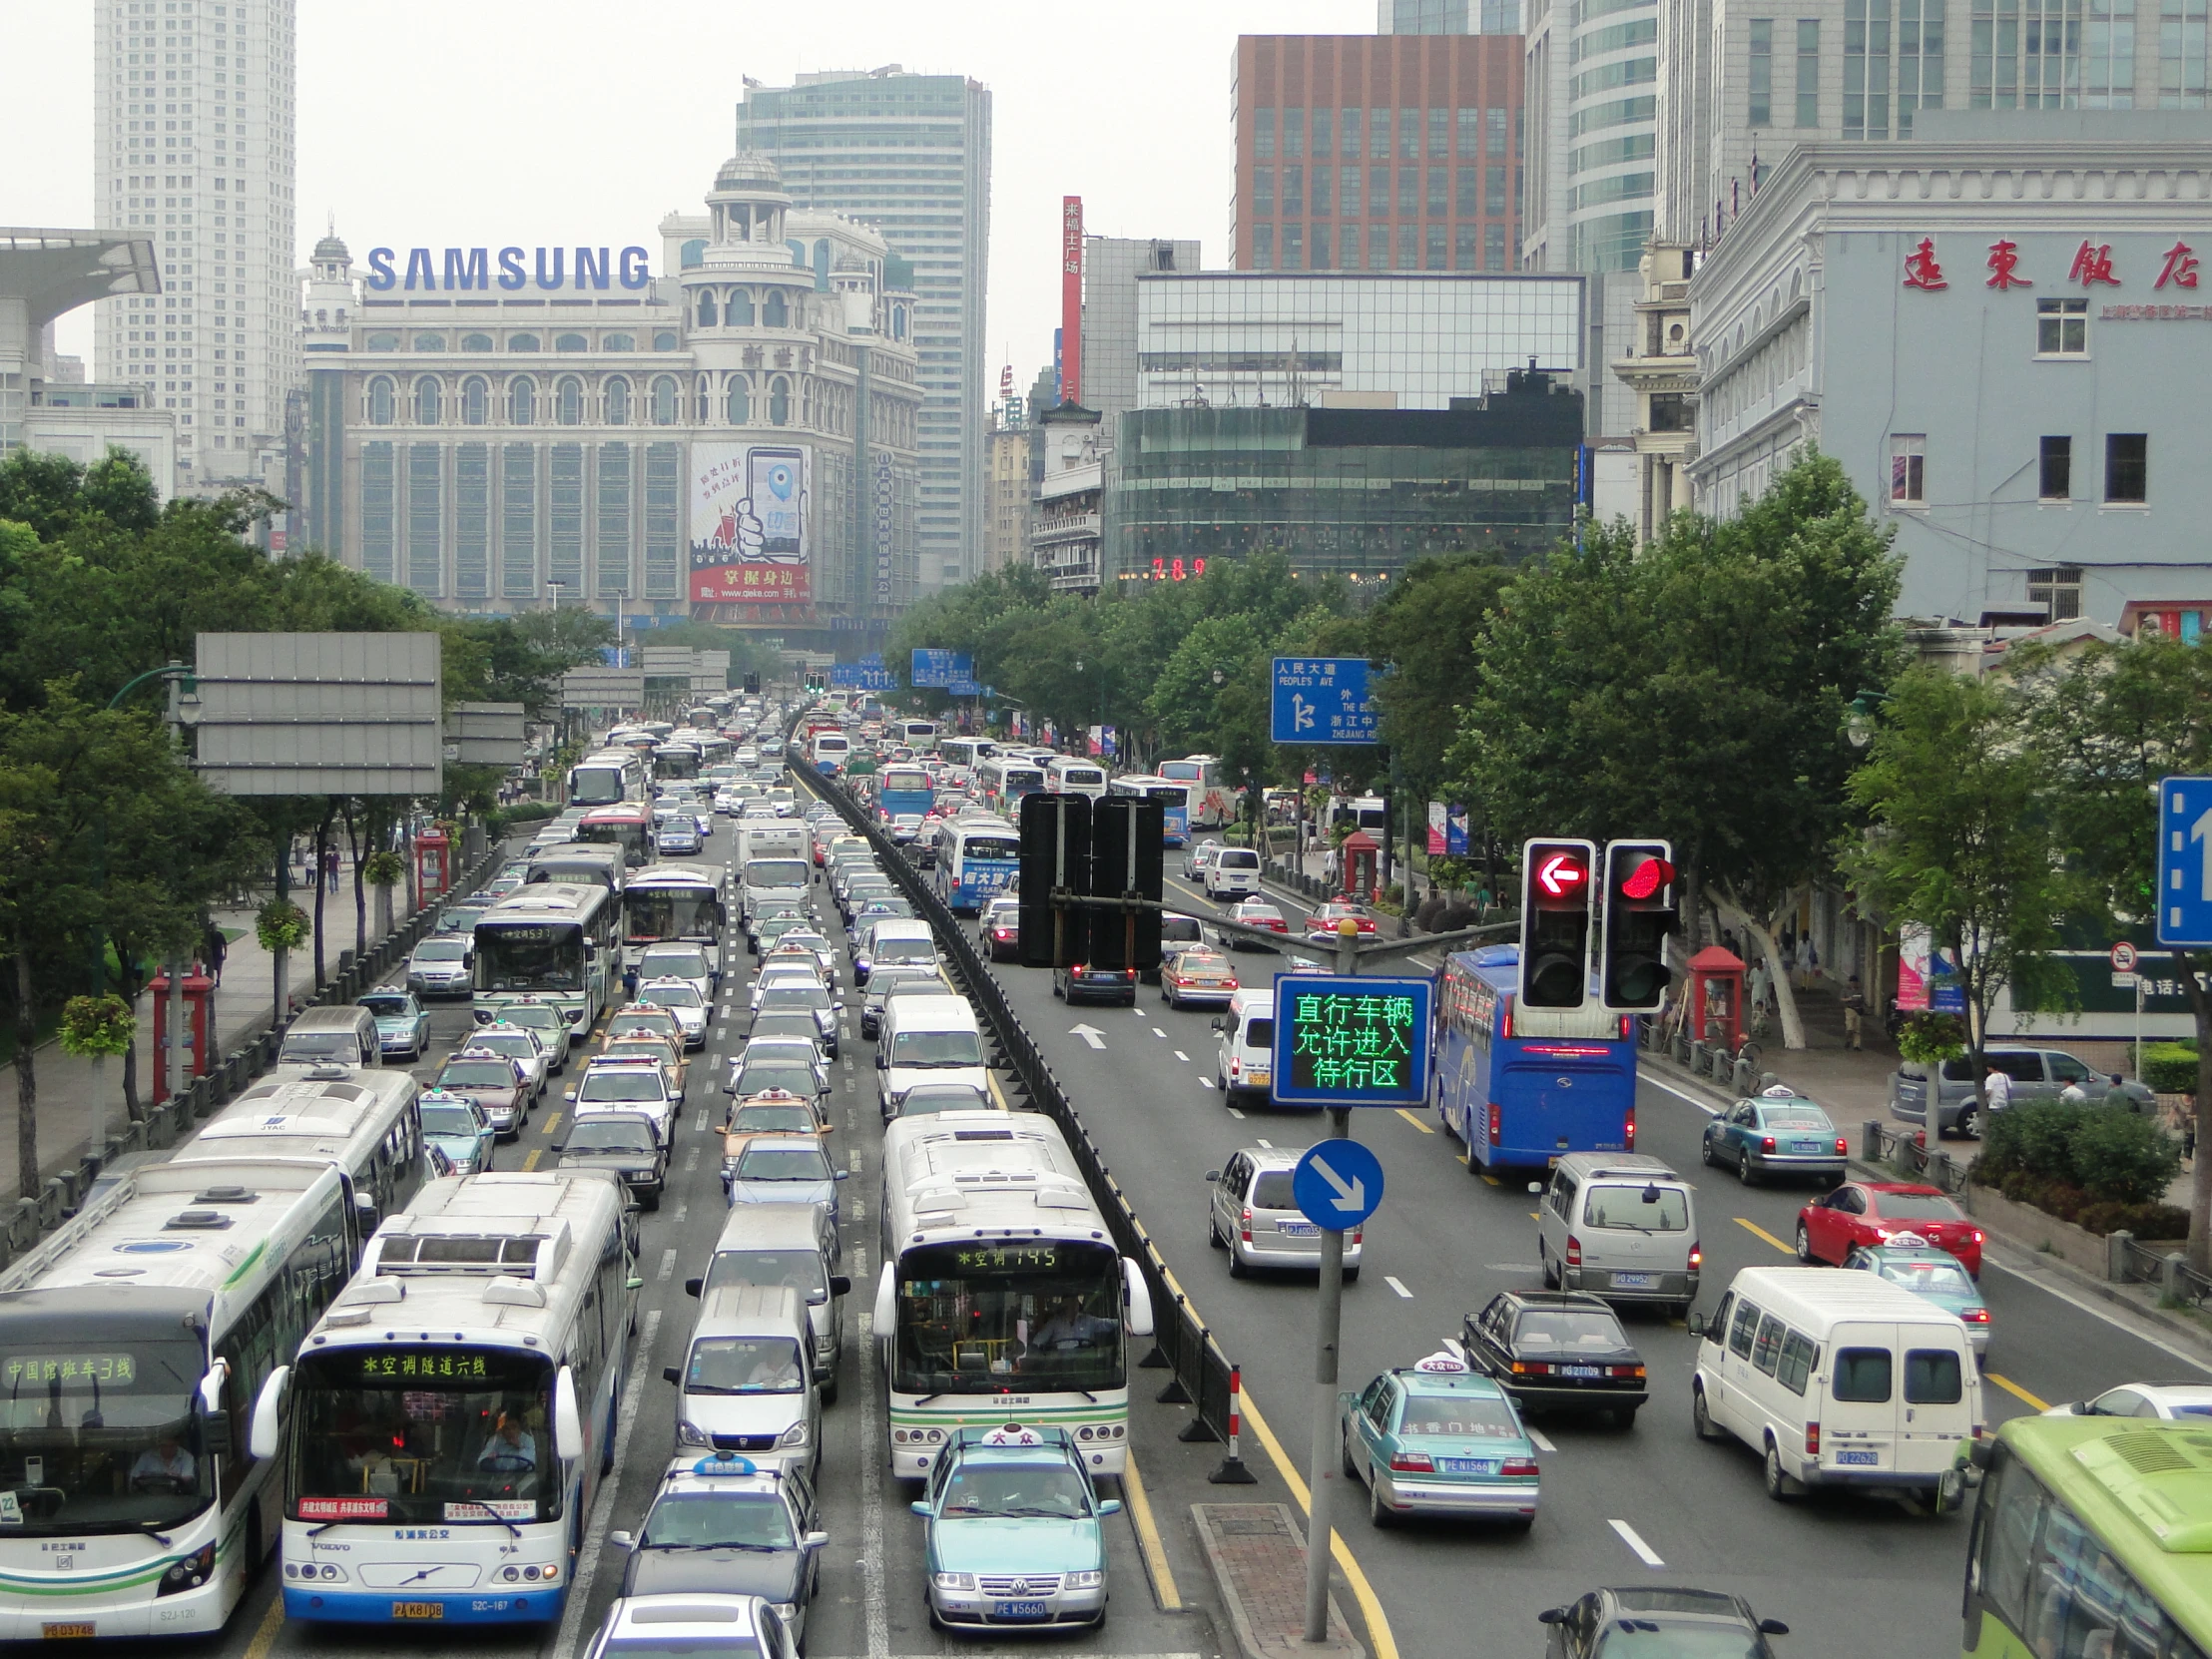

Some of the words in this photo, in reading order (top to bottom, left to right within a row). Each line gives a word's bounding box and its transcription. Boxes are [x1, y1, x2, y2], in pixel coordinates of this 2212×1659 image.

[1064, 203, 1079, 275] 来福士广场
[367, 247, 649, 291] SAMSUNG
[320, 324, 349, 333] World
[722, 587, 779, 599] www.qieke.com
[1278, 663, 1337, 676] 人民大道
[1279, 677, 1313, 687] PEOPLE'S
[1320, 677, 1334, 687] AVE
[1343, 703, 1356, 713] THE
[1332, 730, 1365, 740] ZHEJIANG
[529, 928, 551, 938] 537
[1293, 993, 1413, 1028] 直行车辆
[1292, 1025, 1411, 1058] 允许进入
[1312, 1057, 1399, 1089] 待行区
[973, 1250, 1006, 1267] 空调
[1016, 1248, 1056, 1267] 145
[8, 1357, 132, 1382] 中国馆班车3线
[1403, 1421, 1486, 1435] 书香门地
[992, 1431, 1033, 1444] 大众
[704, 1461, 745, 1473] 蓝色联盟
[1, 1497, 15, 1510] 22
[472, 1600, 508, 1610] S2C-167
[160, 1608, 196, 1621] S2J-120
